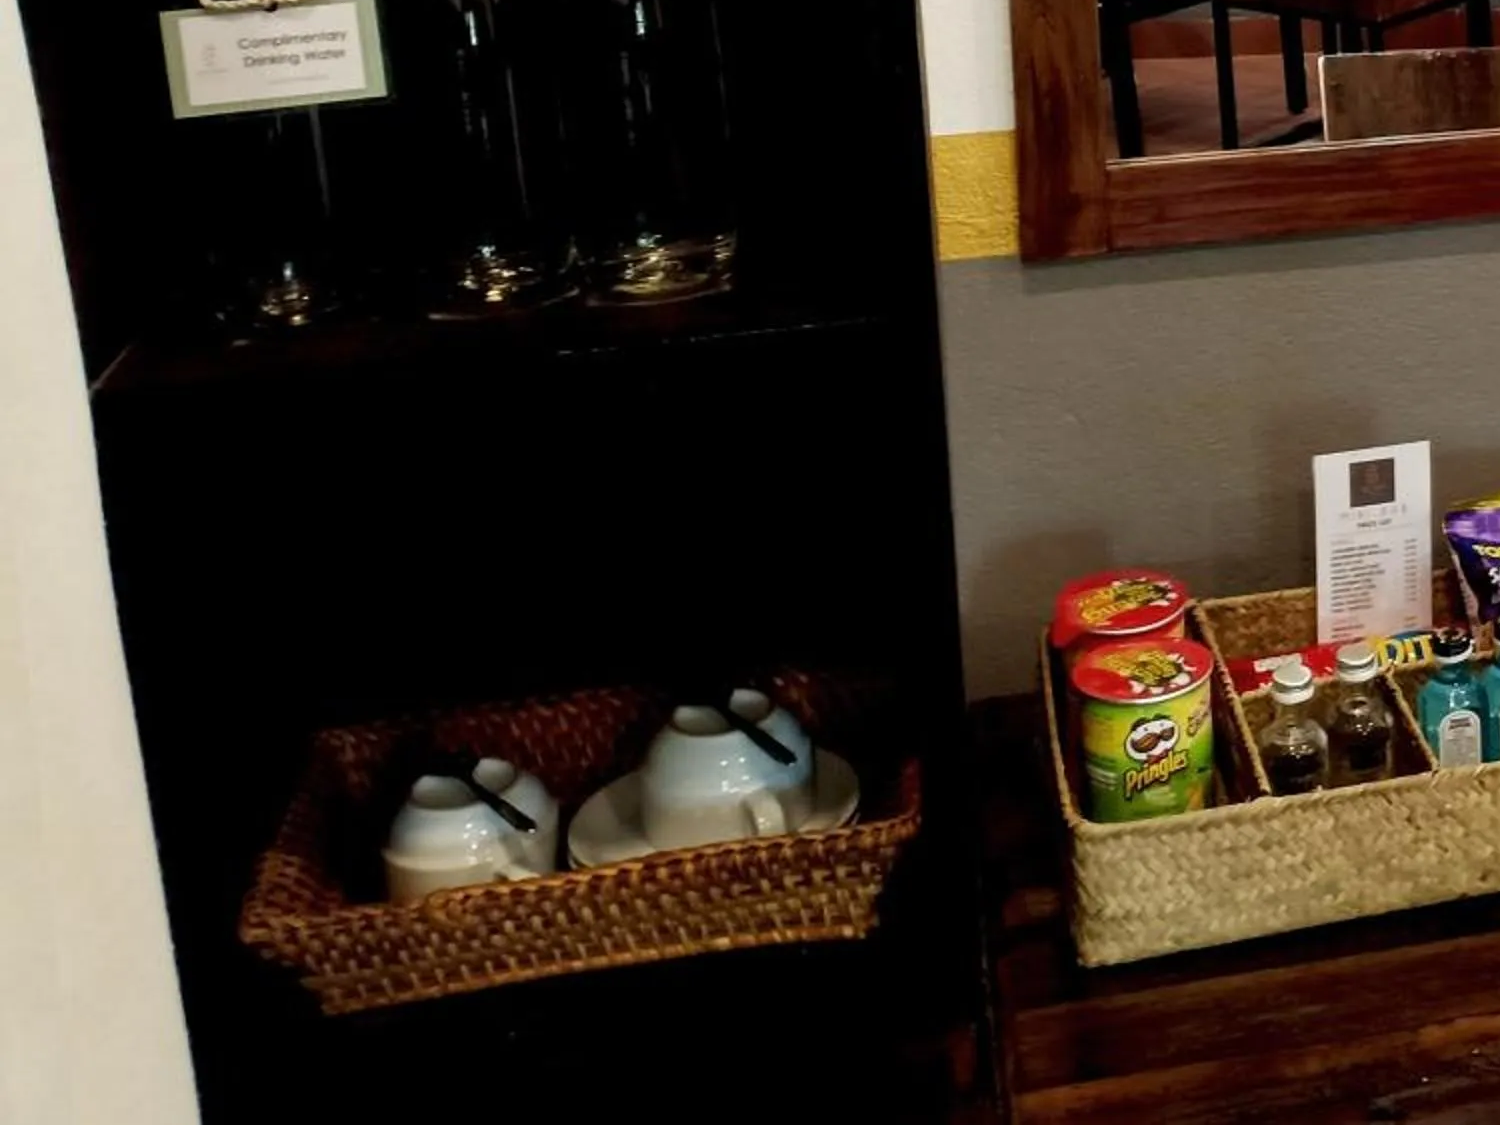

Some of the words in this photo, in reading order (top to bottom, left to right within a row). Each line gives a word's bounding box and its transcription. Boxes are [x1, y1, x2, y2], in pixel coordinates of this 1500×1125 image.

[236, 30, 348, 50] Complimentary
[242, 54, 301, 68] Drinking
[304, 49, 347, 61] Water
[1124, 749, 1188, 801] Pringles
